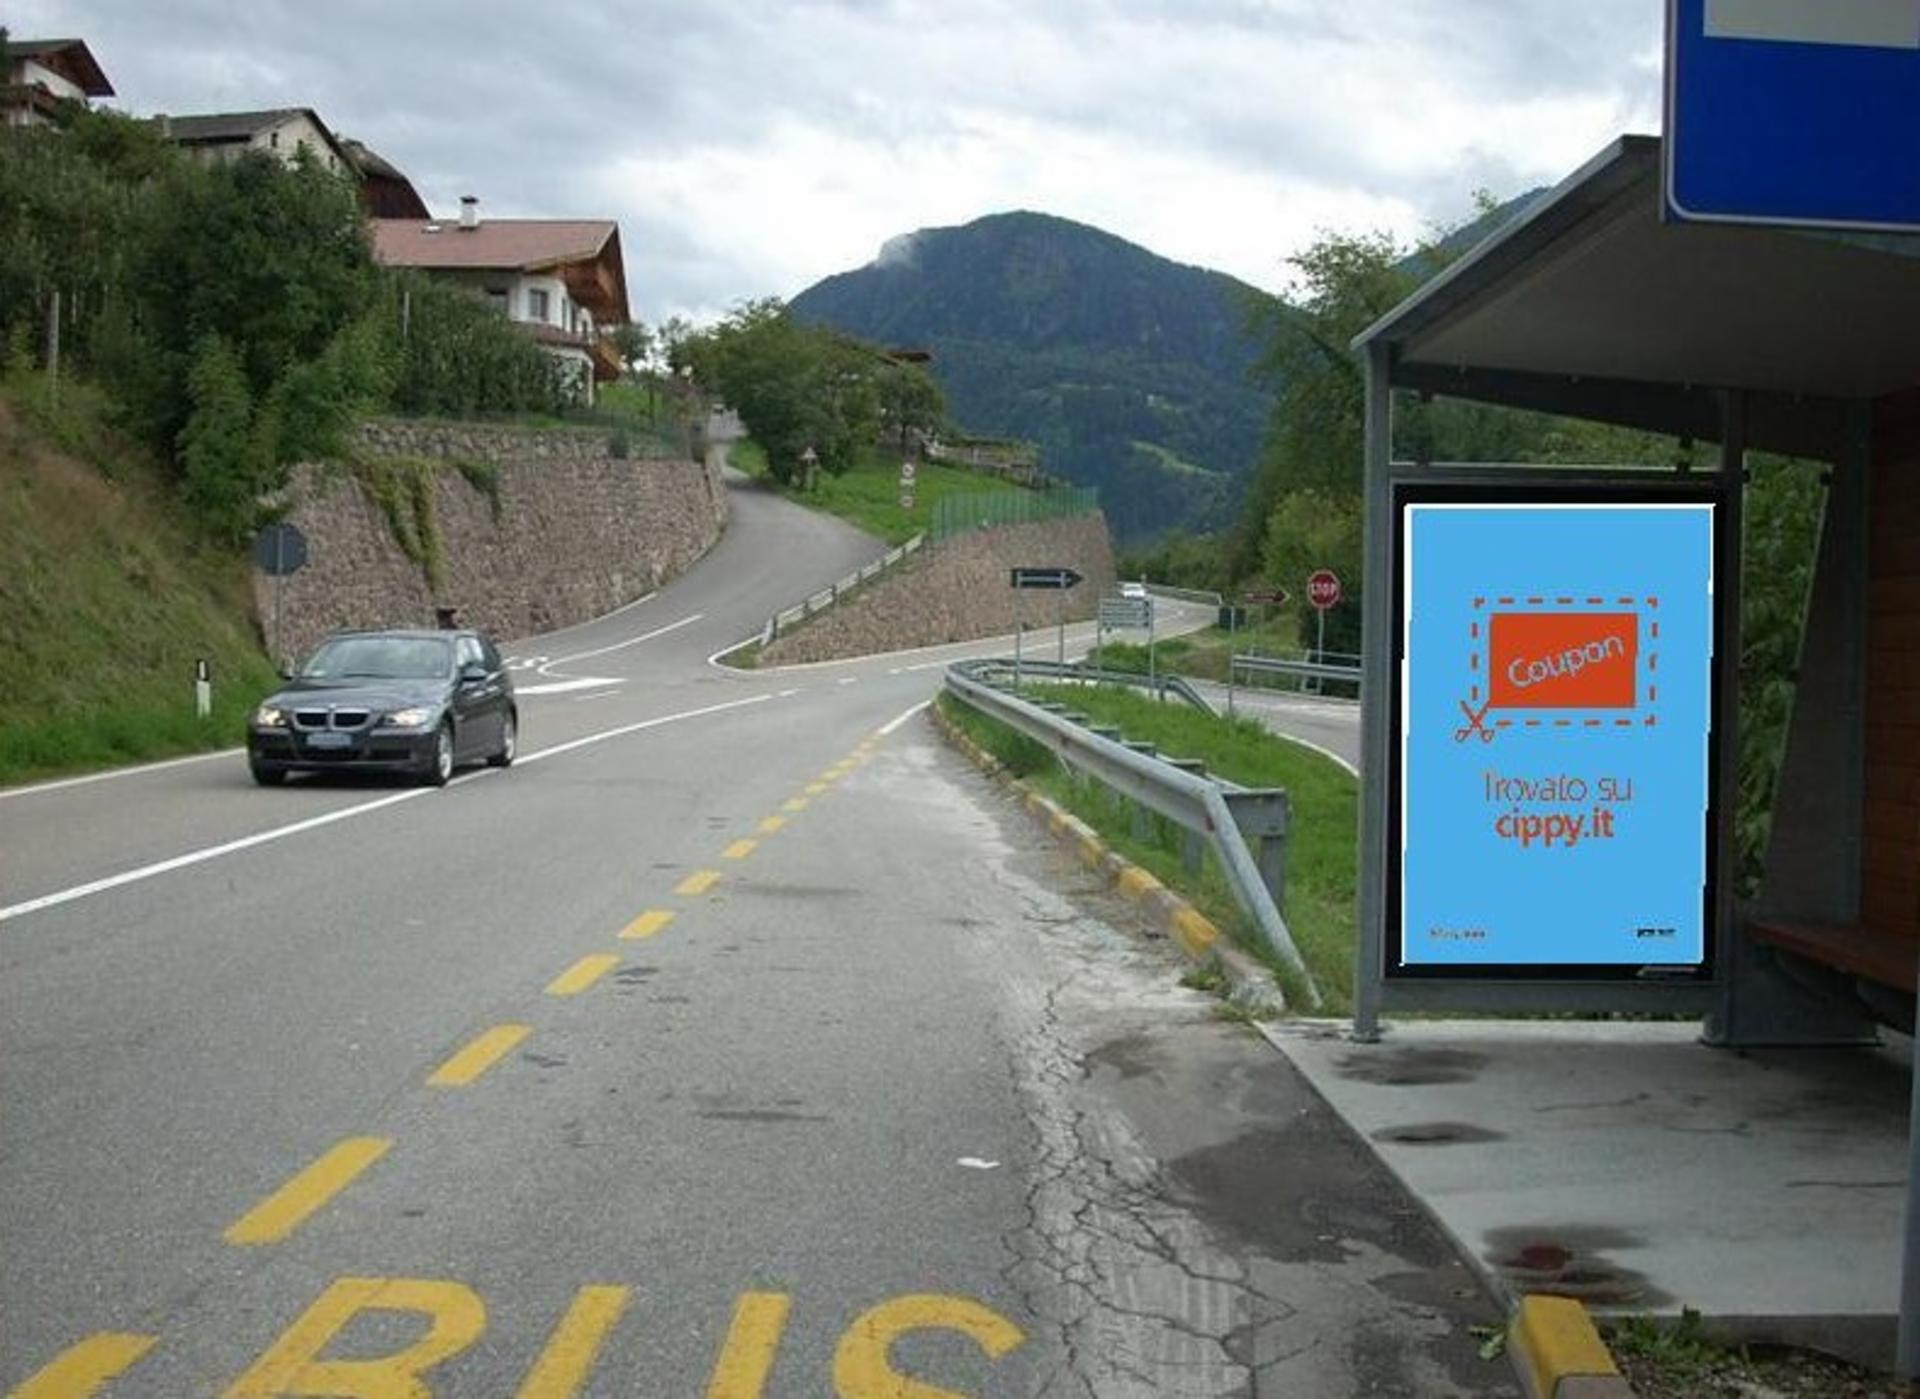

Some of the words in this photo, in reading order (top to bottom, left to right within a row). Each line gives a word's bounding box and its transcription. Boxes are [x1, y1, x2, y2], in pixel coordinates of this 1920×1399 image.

[1311, 583, 1337, 598] STOP
[1507, 635, 1626, 688] Coupon
[1484, 771, 1589, 802] Trovato
[1597, 776, 1633, 802] su
[1495, 806, 1615, 847] cippy.it
